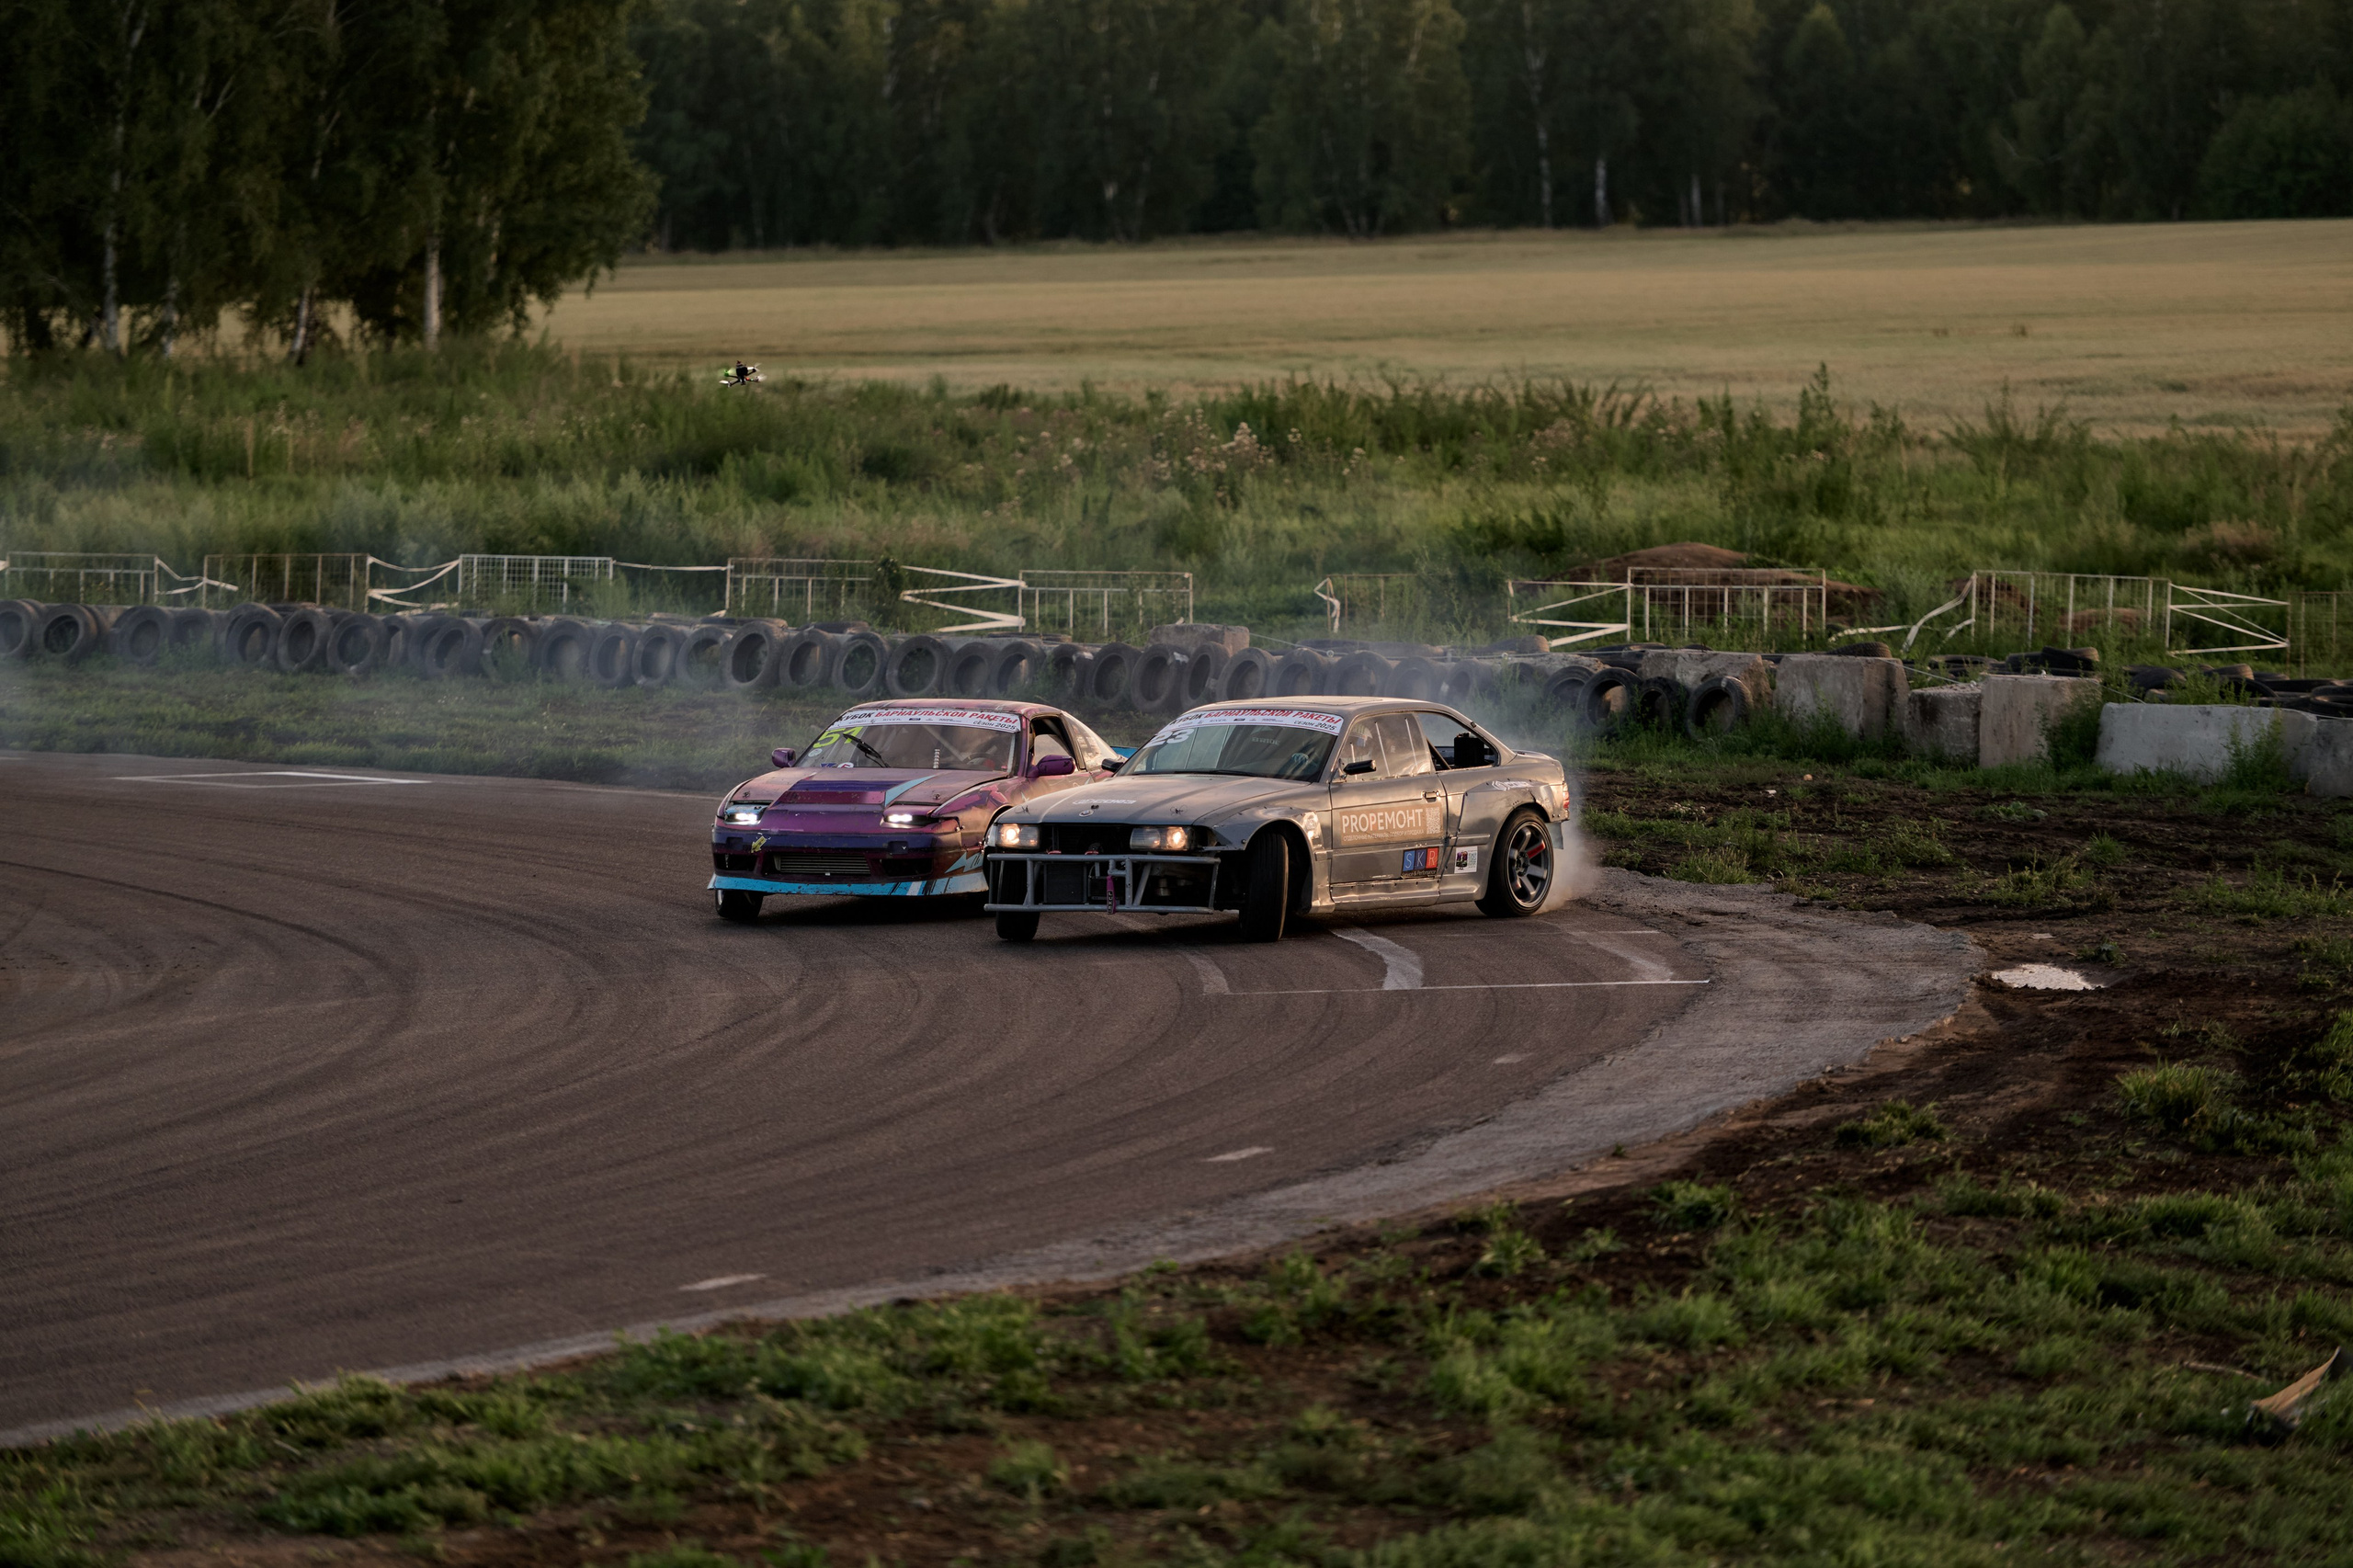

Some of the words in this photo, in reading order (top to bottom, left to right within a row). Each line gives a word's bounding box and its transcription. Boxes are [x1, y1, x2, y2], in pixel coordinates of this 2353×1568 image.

[968, 712, 1018, 724] РАКЕТЫ
[1292, 711, 1342, 724] РАКЕТЫ
[995, 722, 1016, 730] 2025
[1314, 722, 1337, 731] 2025
[813, 726, 864, 748] 51
[1142, 728, 1195, 749] 23
[1404, 850, 1436, 869] SKR
